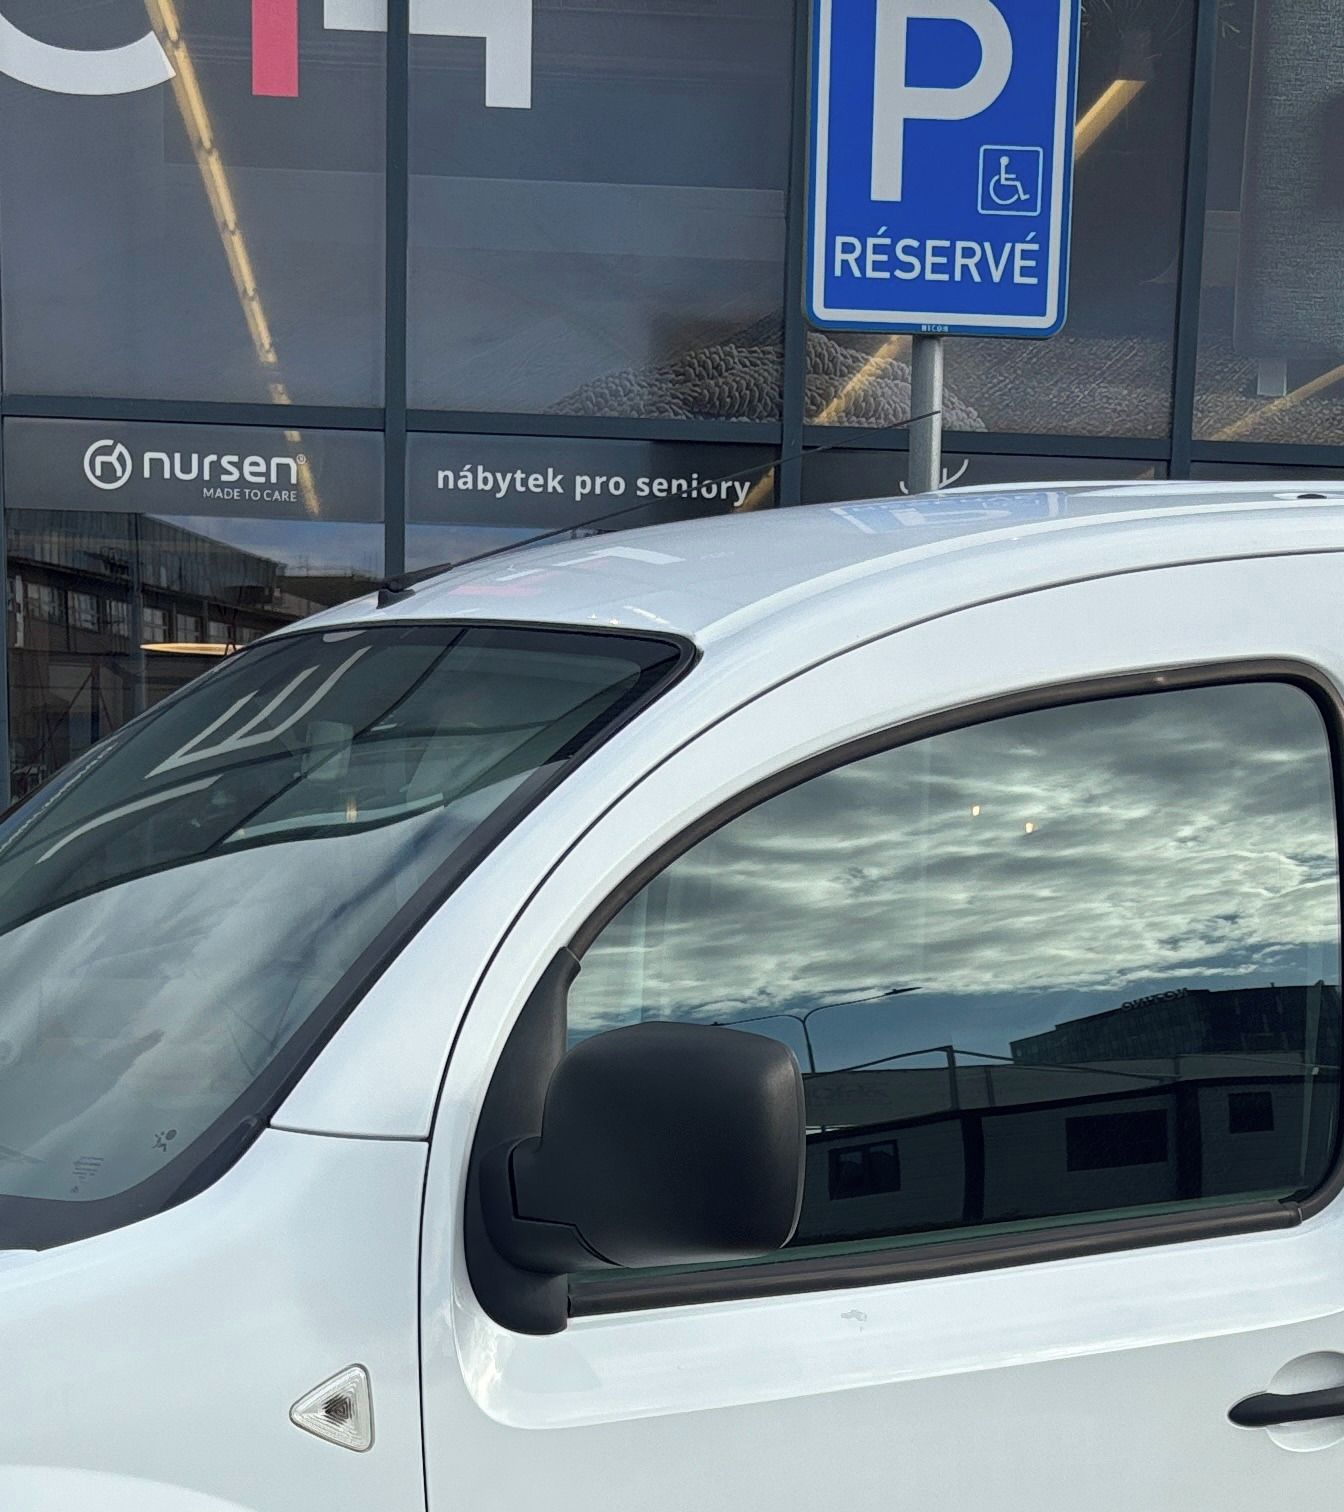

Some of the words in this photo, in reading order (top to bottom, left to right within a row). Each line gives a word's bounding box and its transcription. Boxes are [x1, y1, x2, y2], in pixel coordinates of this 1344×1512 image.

[870, 0, 1013, 202] P
[833, 226, 1041, 285] RÉSERVÉ
[203, 487, 241, 500] MADE
[243, 488, 261, 501] TO
[263, 489, 297, 502] CARE
[437, 464, 564, 499] nábytek
[575, 475, 626, 501] pro
[636, 473, 752, 507] seniory
